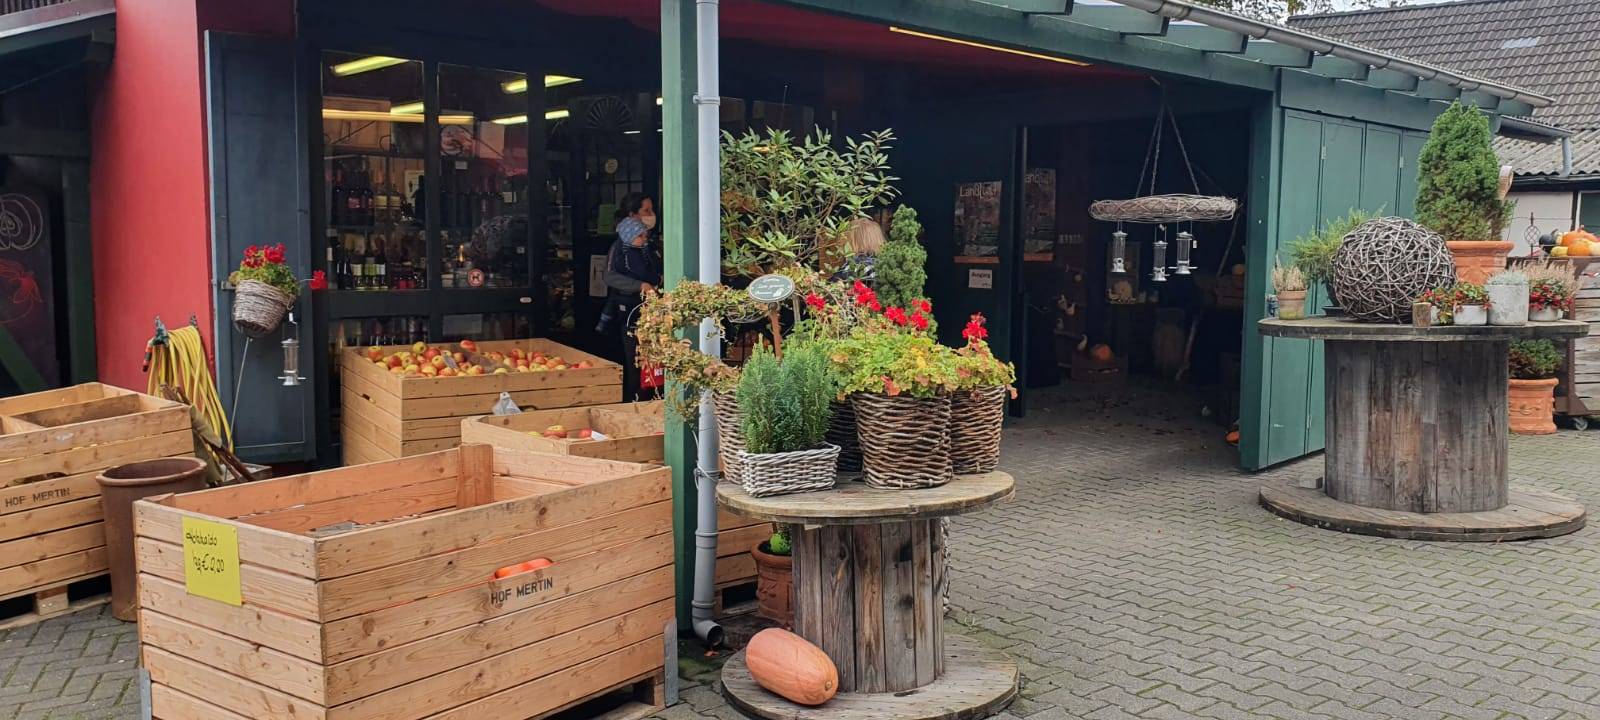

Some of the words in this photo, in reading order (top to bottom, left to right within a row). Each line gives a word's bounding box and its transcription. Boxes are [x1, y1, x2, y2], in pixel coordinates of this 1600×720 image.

[5, 496, 26, 508] HOF
[32, 488, 71, 502] MERTIN
[491, 588, 512, 605] HOF
[516, 577, 553, 598] MERTIN
